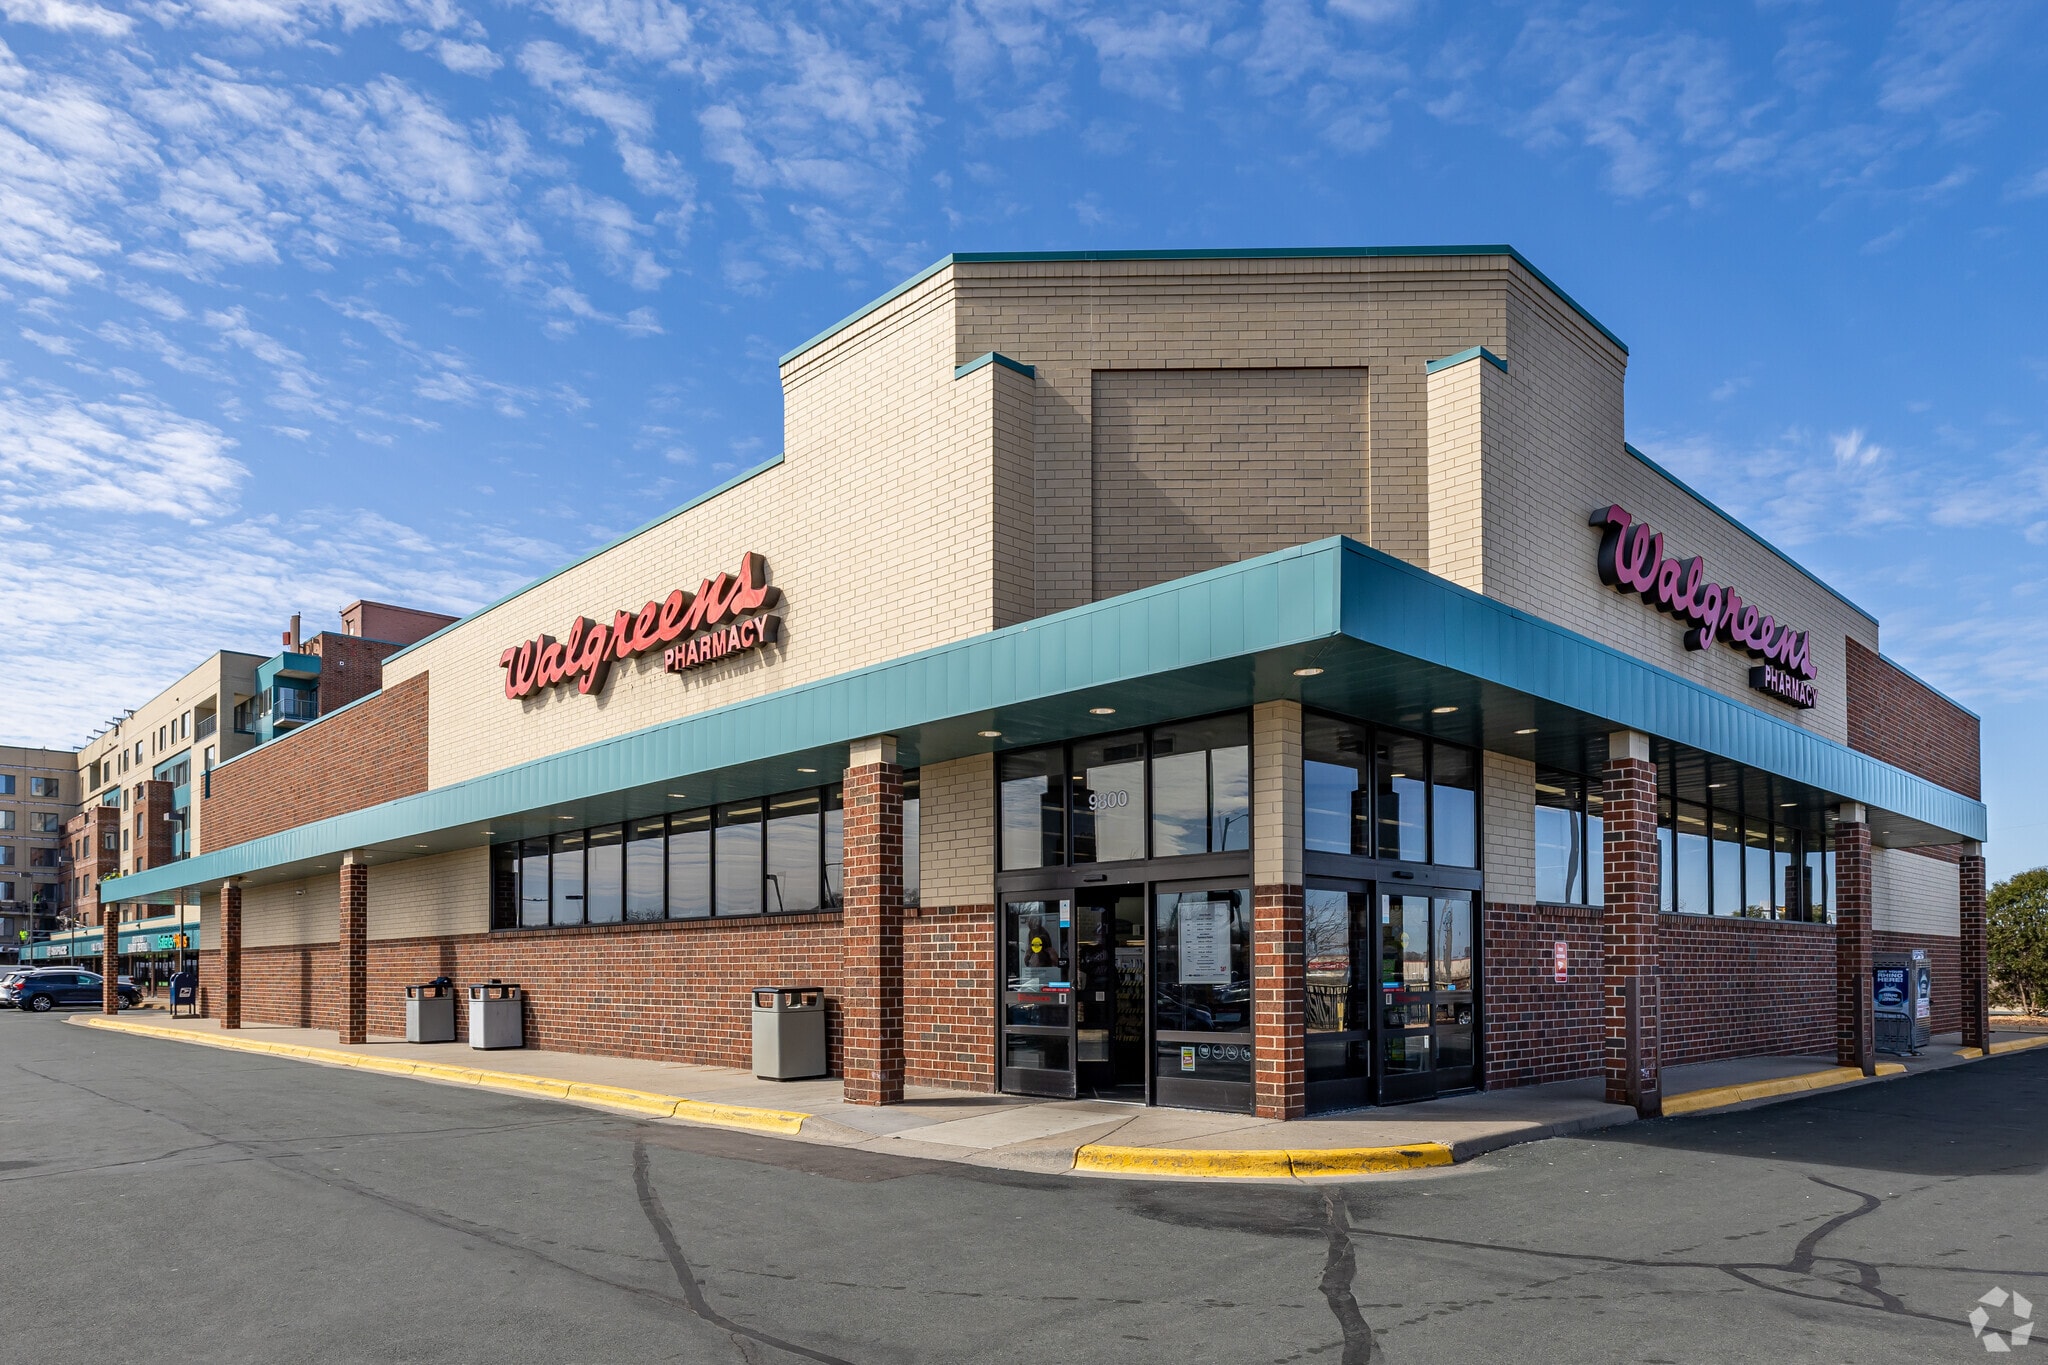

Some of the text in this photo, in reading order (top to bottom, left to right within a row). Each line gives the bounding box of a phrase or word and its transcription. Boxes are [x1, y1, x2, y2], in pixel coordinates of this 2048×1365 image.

[1605, 503, 1818, 680] Walgreens
[499, 551, 768, 699] Walgreens
[664, 613, 768, 674] PHARMACY
[1764, 664, 1818, 709] PHARMACY
[1088, 790, 1127, 811] 9800
